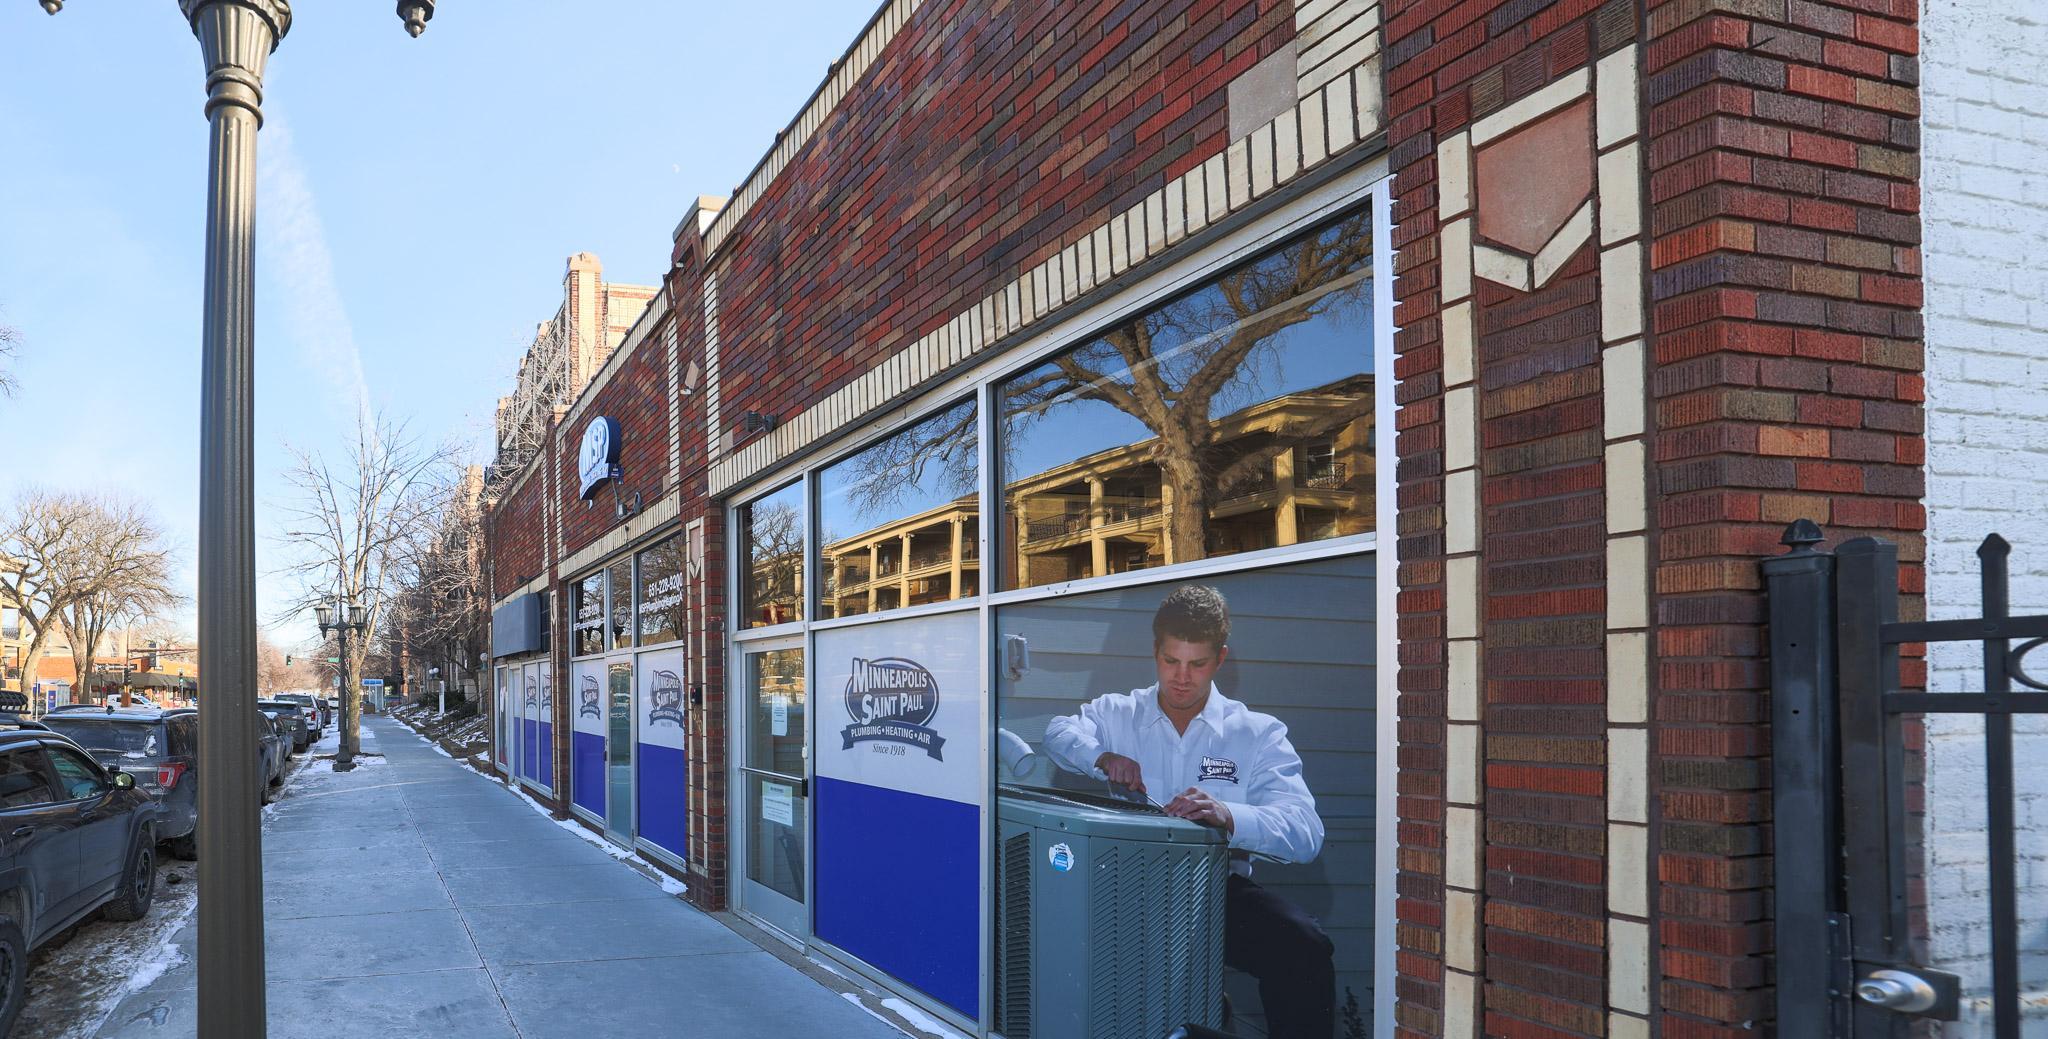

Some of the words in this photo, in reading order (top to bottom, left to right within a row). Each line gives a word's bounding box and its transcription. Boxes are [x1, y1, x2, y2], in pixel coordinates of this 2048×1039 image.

[852, 658, 928, 693] MINNEAPOLIS
[861, 693, 897, 725] SAINT
[900, 692, 924, 716] PAUL
[850, 726, 881, 738] PLUMBING
[885, 726, 914, 739] HEATING
[918, 732, 931, 744] AIR
[872, 743, 890, 754] Since
[890, 744, 906, 756] 1918
